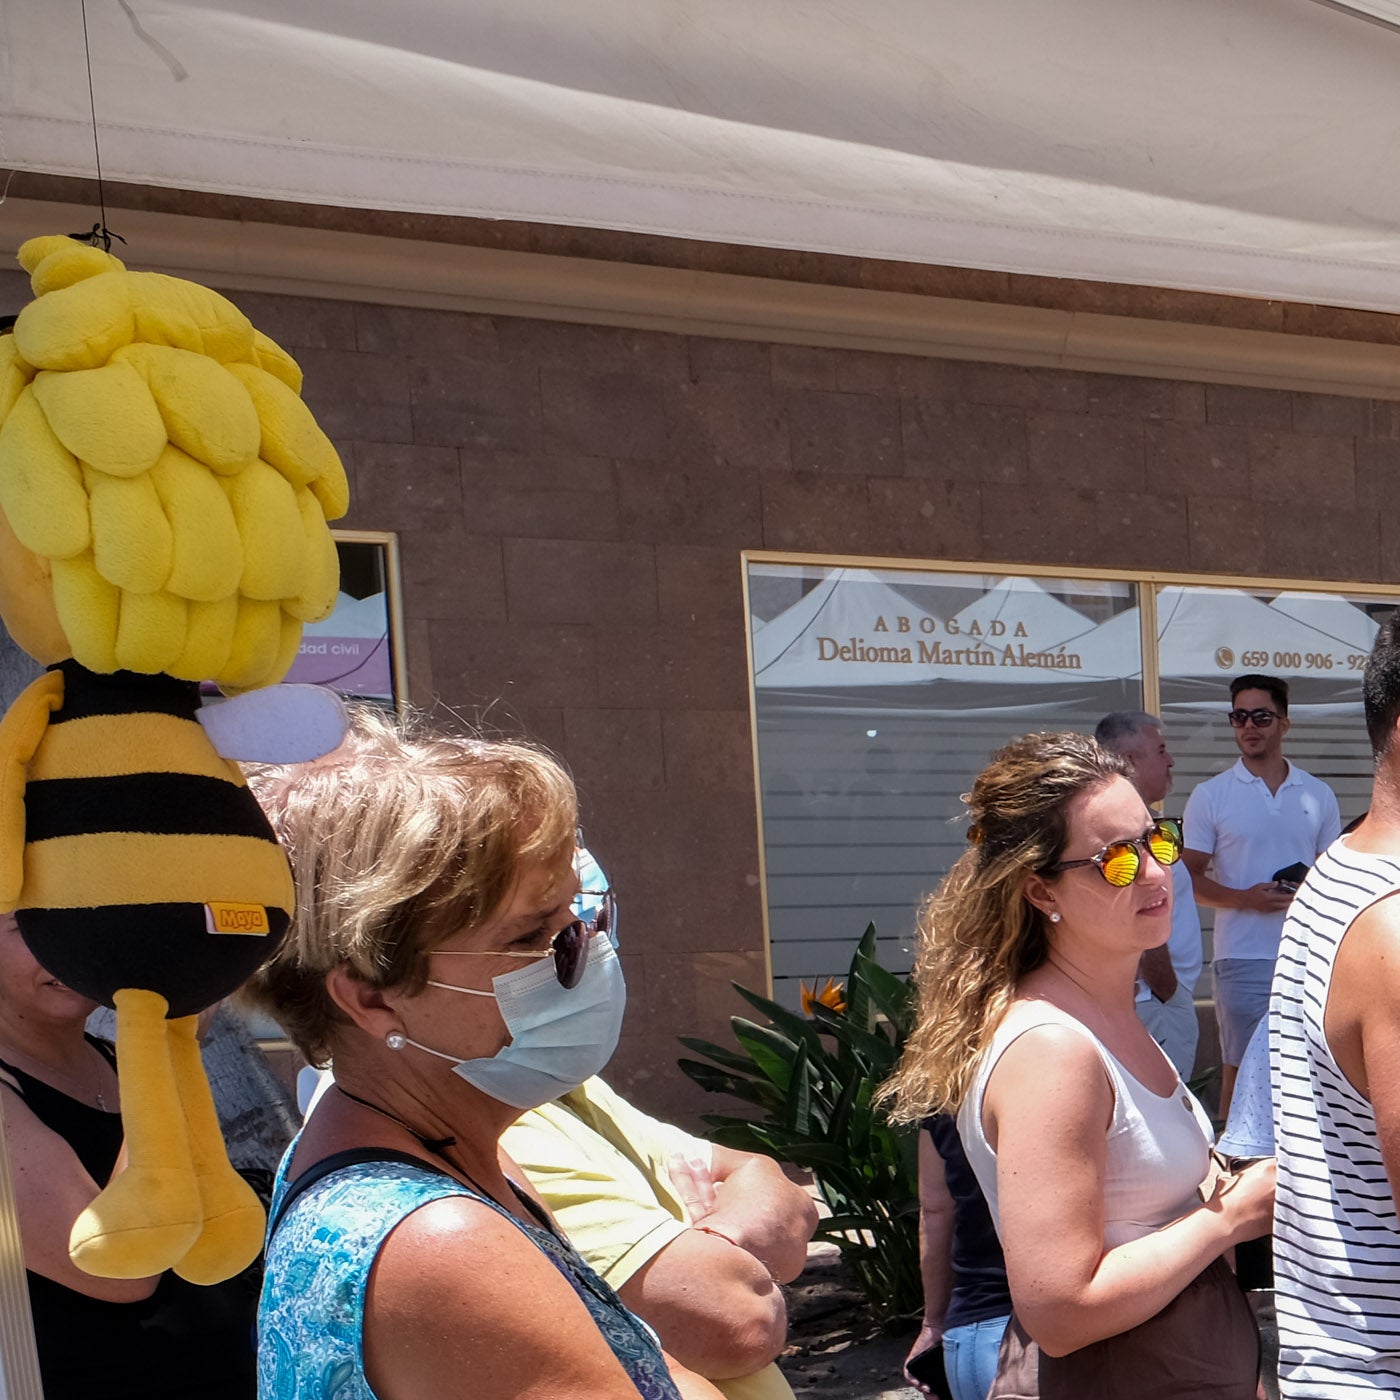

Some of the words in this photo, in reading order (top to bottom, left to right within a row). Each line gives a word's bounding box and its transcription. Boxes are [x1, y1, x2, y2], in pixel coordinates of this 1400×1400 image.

[874, 615, 1028, 637] ABOGADA
[331, 643, 359, 655] civil
[816, 637, 912, 664] Delioma
[917, 640, 995, 666] Martín
[1000, 643, 1082, 669] Alemán
[1241, 651, 1269, 667] 659
[1274, 652, 1301, 668] 000
[1306, 653, 1334, 669] 906
[221, 909, 262, 930] Maya
